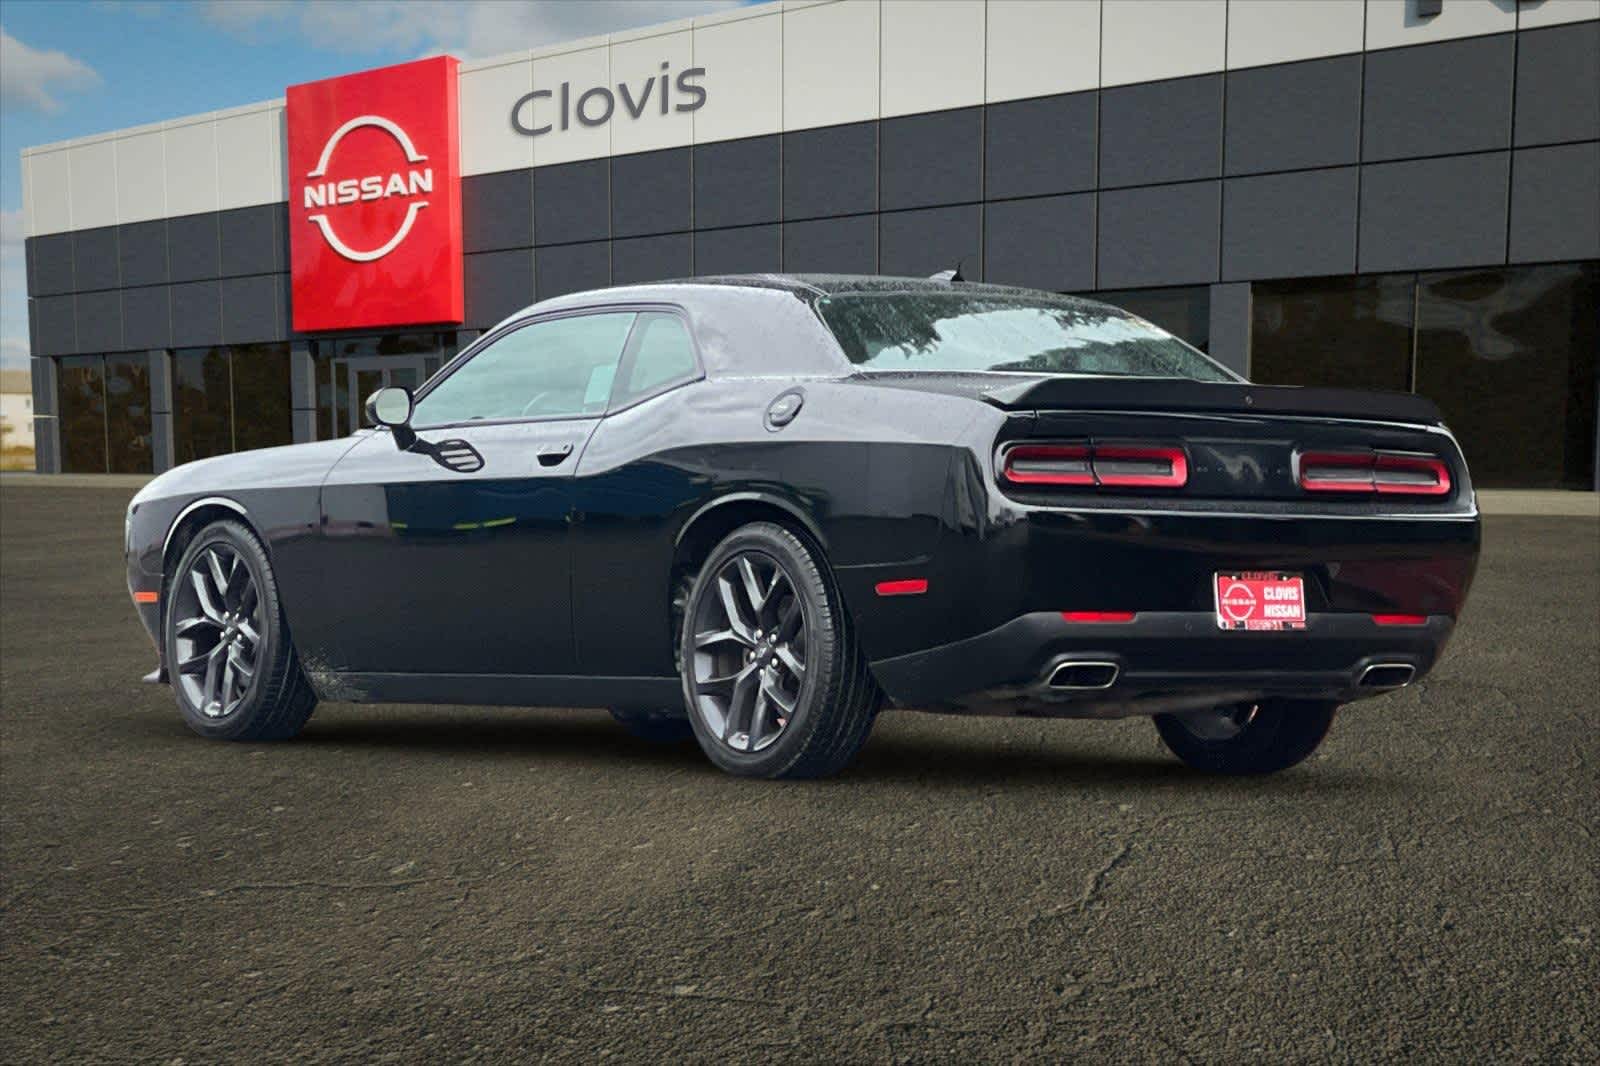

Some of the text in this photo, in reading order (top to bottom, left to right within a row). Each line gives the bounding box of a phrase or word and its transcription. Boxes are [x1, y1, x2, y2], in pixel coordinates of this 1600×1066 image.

[511, 62, 707, 136] Clovis
[303, 167, 433, 209] NISSAN
[1263, 587, 1298, 600] CLOVIS
[1263, 604, 1301, 618] NISSAN
